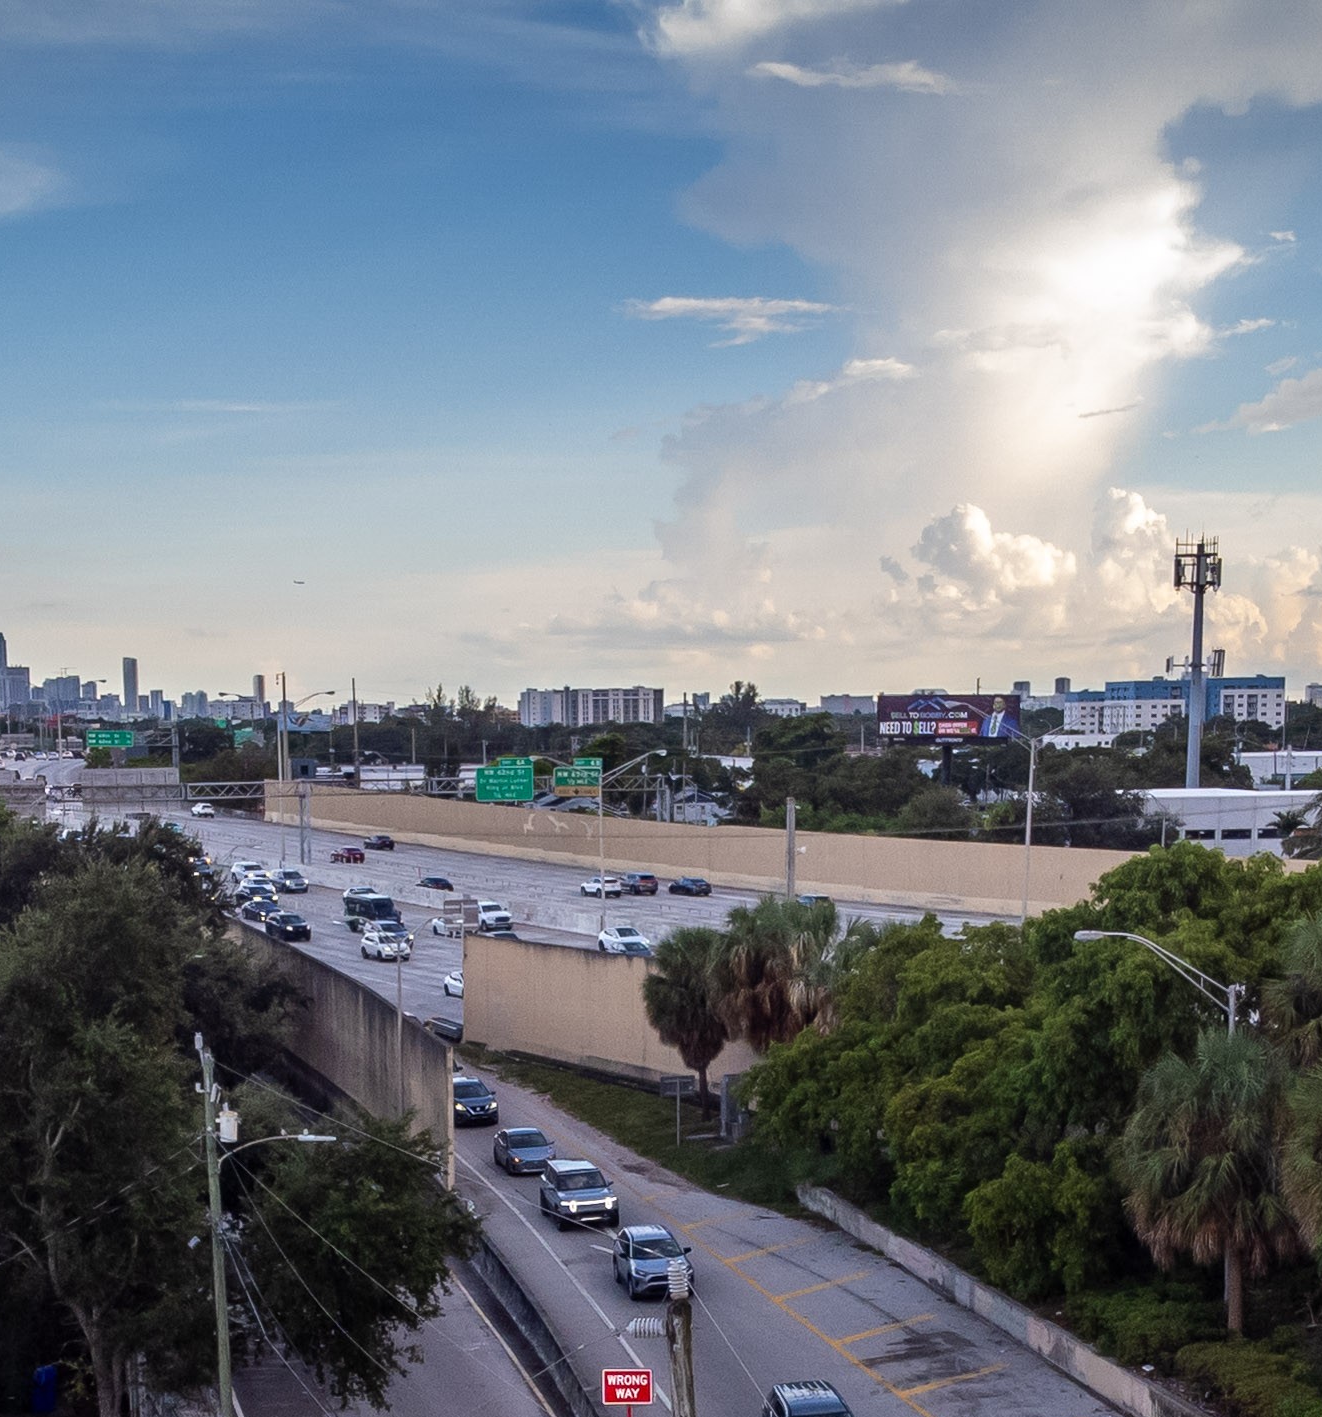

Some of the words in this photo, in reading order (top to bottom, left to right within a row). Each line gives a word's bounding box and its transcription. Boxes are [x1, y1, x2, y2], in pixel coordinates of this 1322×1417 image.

[879, 721, 901, 735] NEED
[902, 721, 912, 735] TO
[606, 1374, 648, 1386] WRONG
[614, 1387, 640, 1399] WAY
